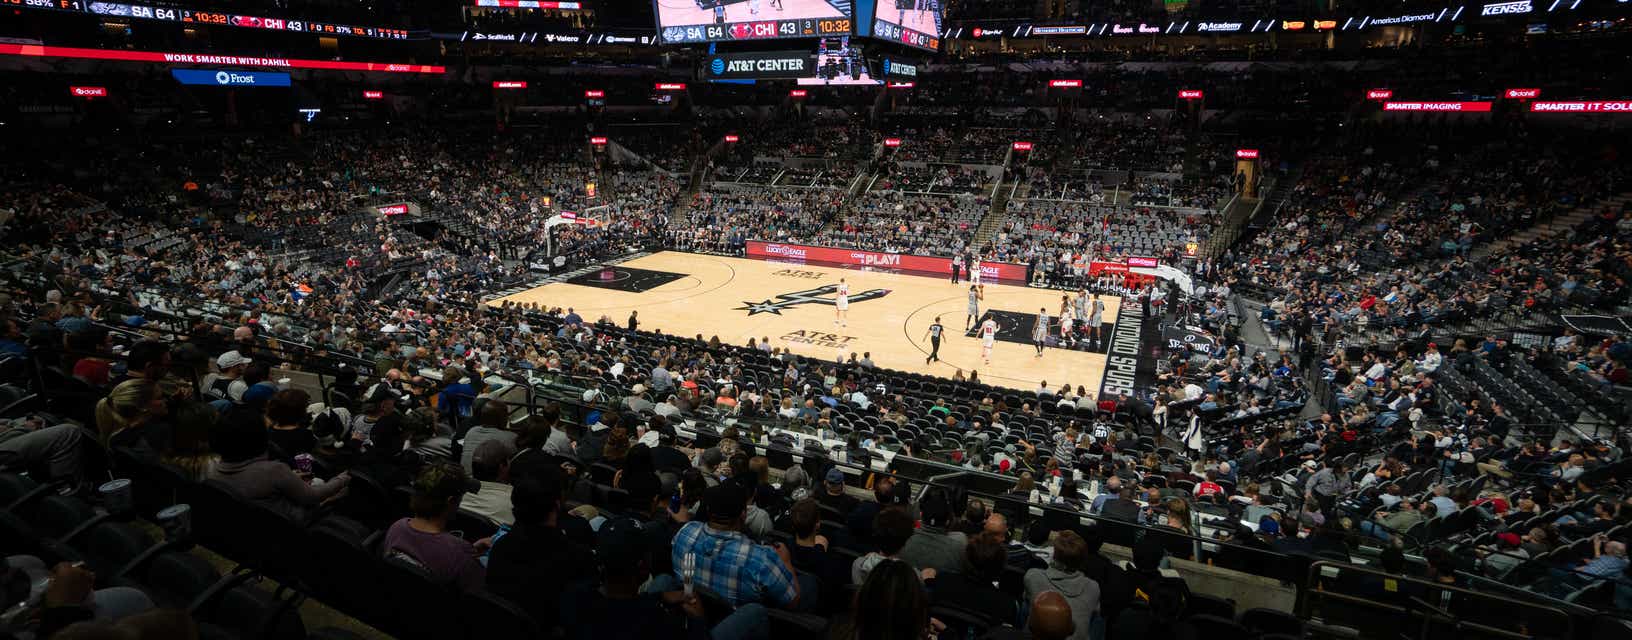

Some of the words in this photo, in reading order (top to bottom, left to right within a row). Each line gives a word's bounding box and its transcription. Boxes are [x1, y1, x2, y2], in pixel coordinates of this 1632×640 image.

[132, 6, 152, 18] SA
[156, 9, 175, 20] 64
[195, 11, 227, 24] 10:32
[265, 18, 283, 30] CHI
[287, 21, 302, 31] 43
[1370, 16, 1401, 25] Americus
[1401, 13, 1434, 22] Diamond
[687, 27, 702, 39] SA
[707, 27, 723, 38] 64
[755, 24, 775, 36] CHI
[780, 23, 796, 34] 43
[819, 19, 850, 33] 10:32
[1208, 22, 1242, 30] Academy
[164, 53, 194, 63] WORK
[196, 55, 237, 65] SMARTER
[239, 57, 261, 66] WITH
[262, 58, 291, 67] DAHILL
[727, 60, 755, 72] AT&T
[757, 58, 804, 72] CENTER
[230, 73, 255, 83] Frost
[1534, 102, 1585, 111] SMARTER
[865, 254, 900, 265] PLAY!
[1103, 356, 1137, 397] SPURS
